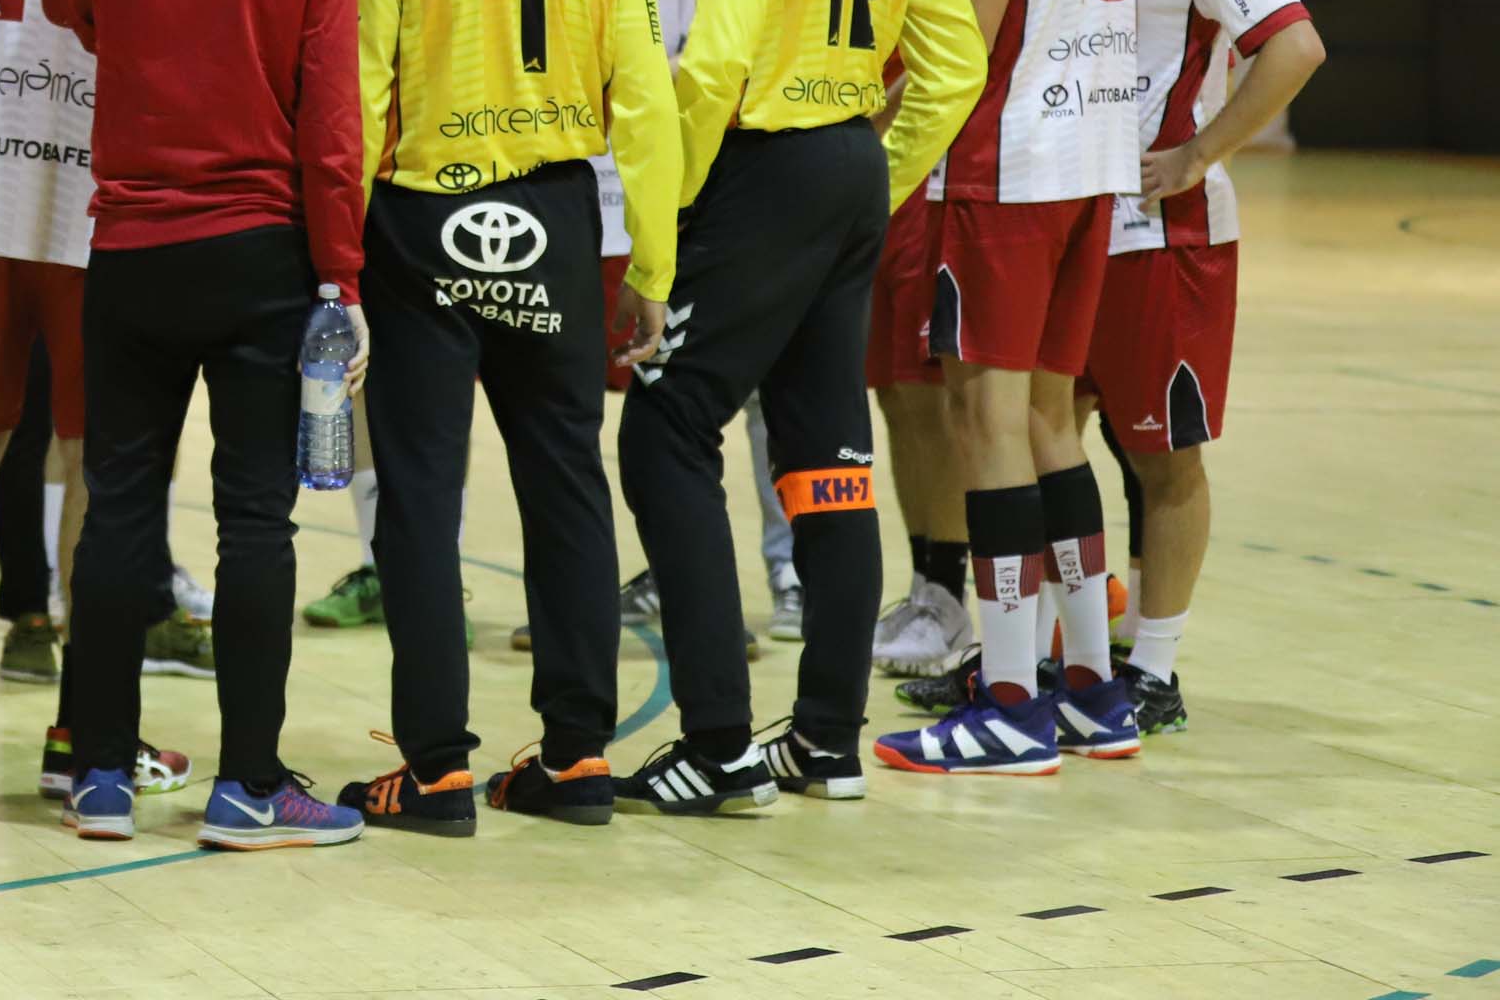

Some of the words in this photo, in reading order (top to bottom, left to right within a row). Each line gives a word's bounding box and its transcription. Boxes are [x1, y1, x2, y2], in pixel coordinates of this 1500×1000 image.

[811, 476, 869, 505] KH-7
[998, 565, 1020, 614] KIPSTA
[1058, 548, 1083, 596] KIPSTA
